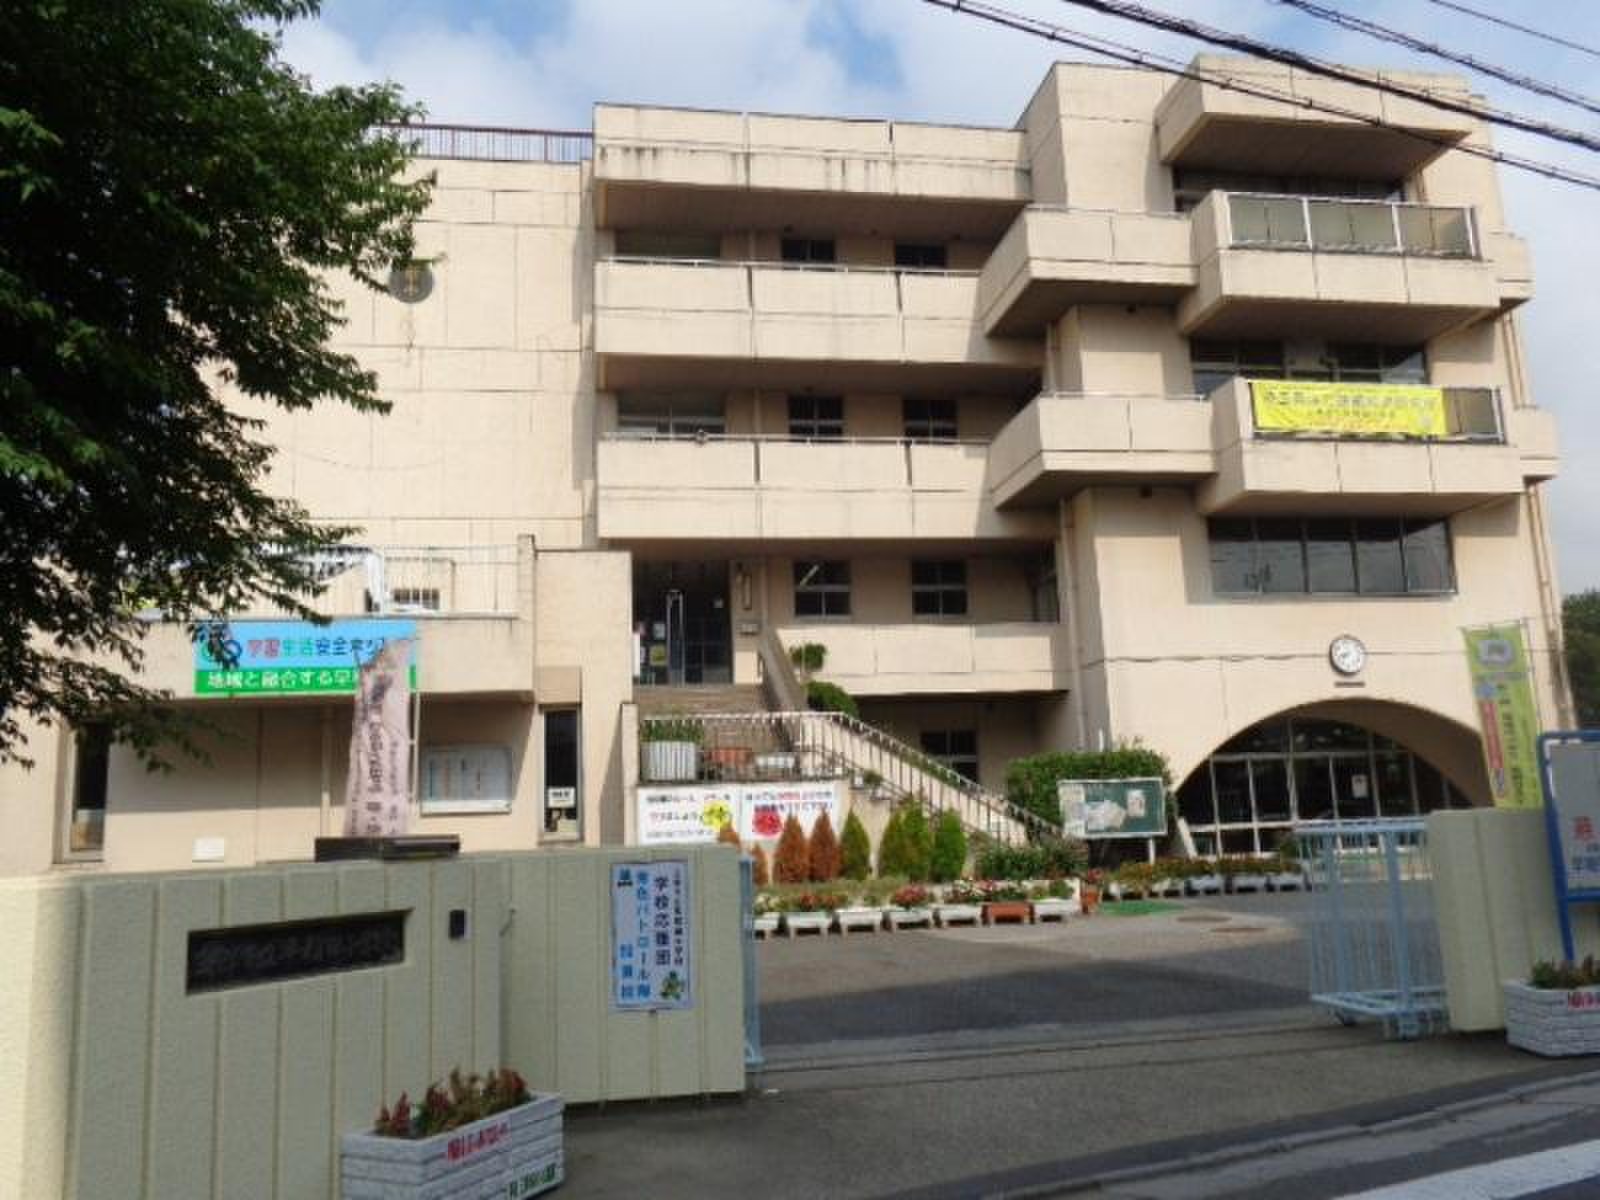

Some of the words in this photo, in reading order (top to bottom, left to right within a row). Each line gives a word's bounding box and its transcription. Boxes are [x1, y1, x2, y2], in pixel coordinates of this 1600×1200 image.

[655, 876, 671, 966] 学校応援団
